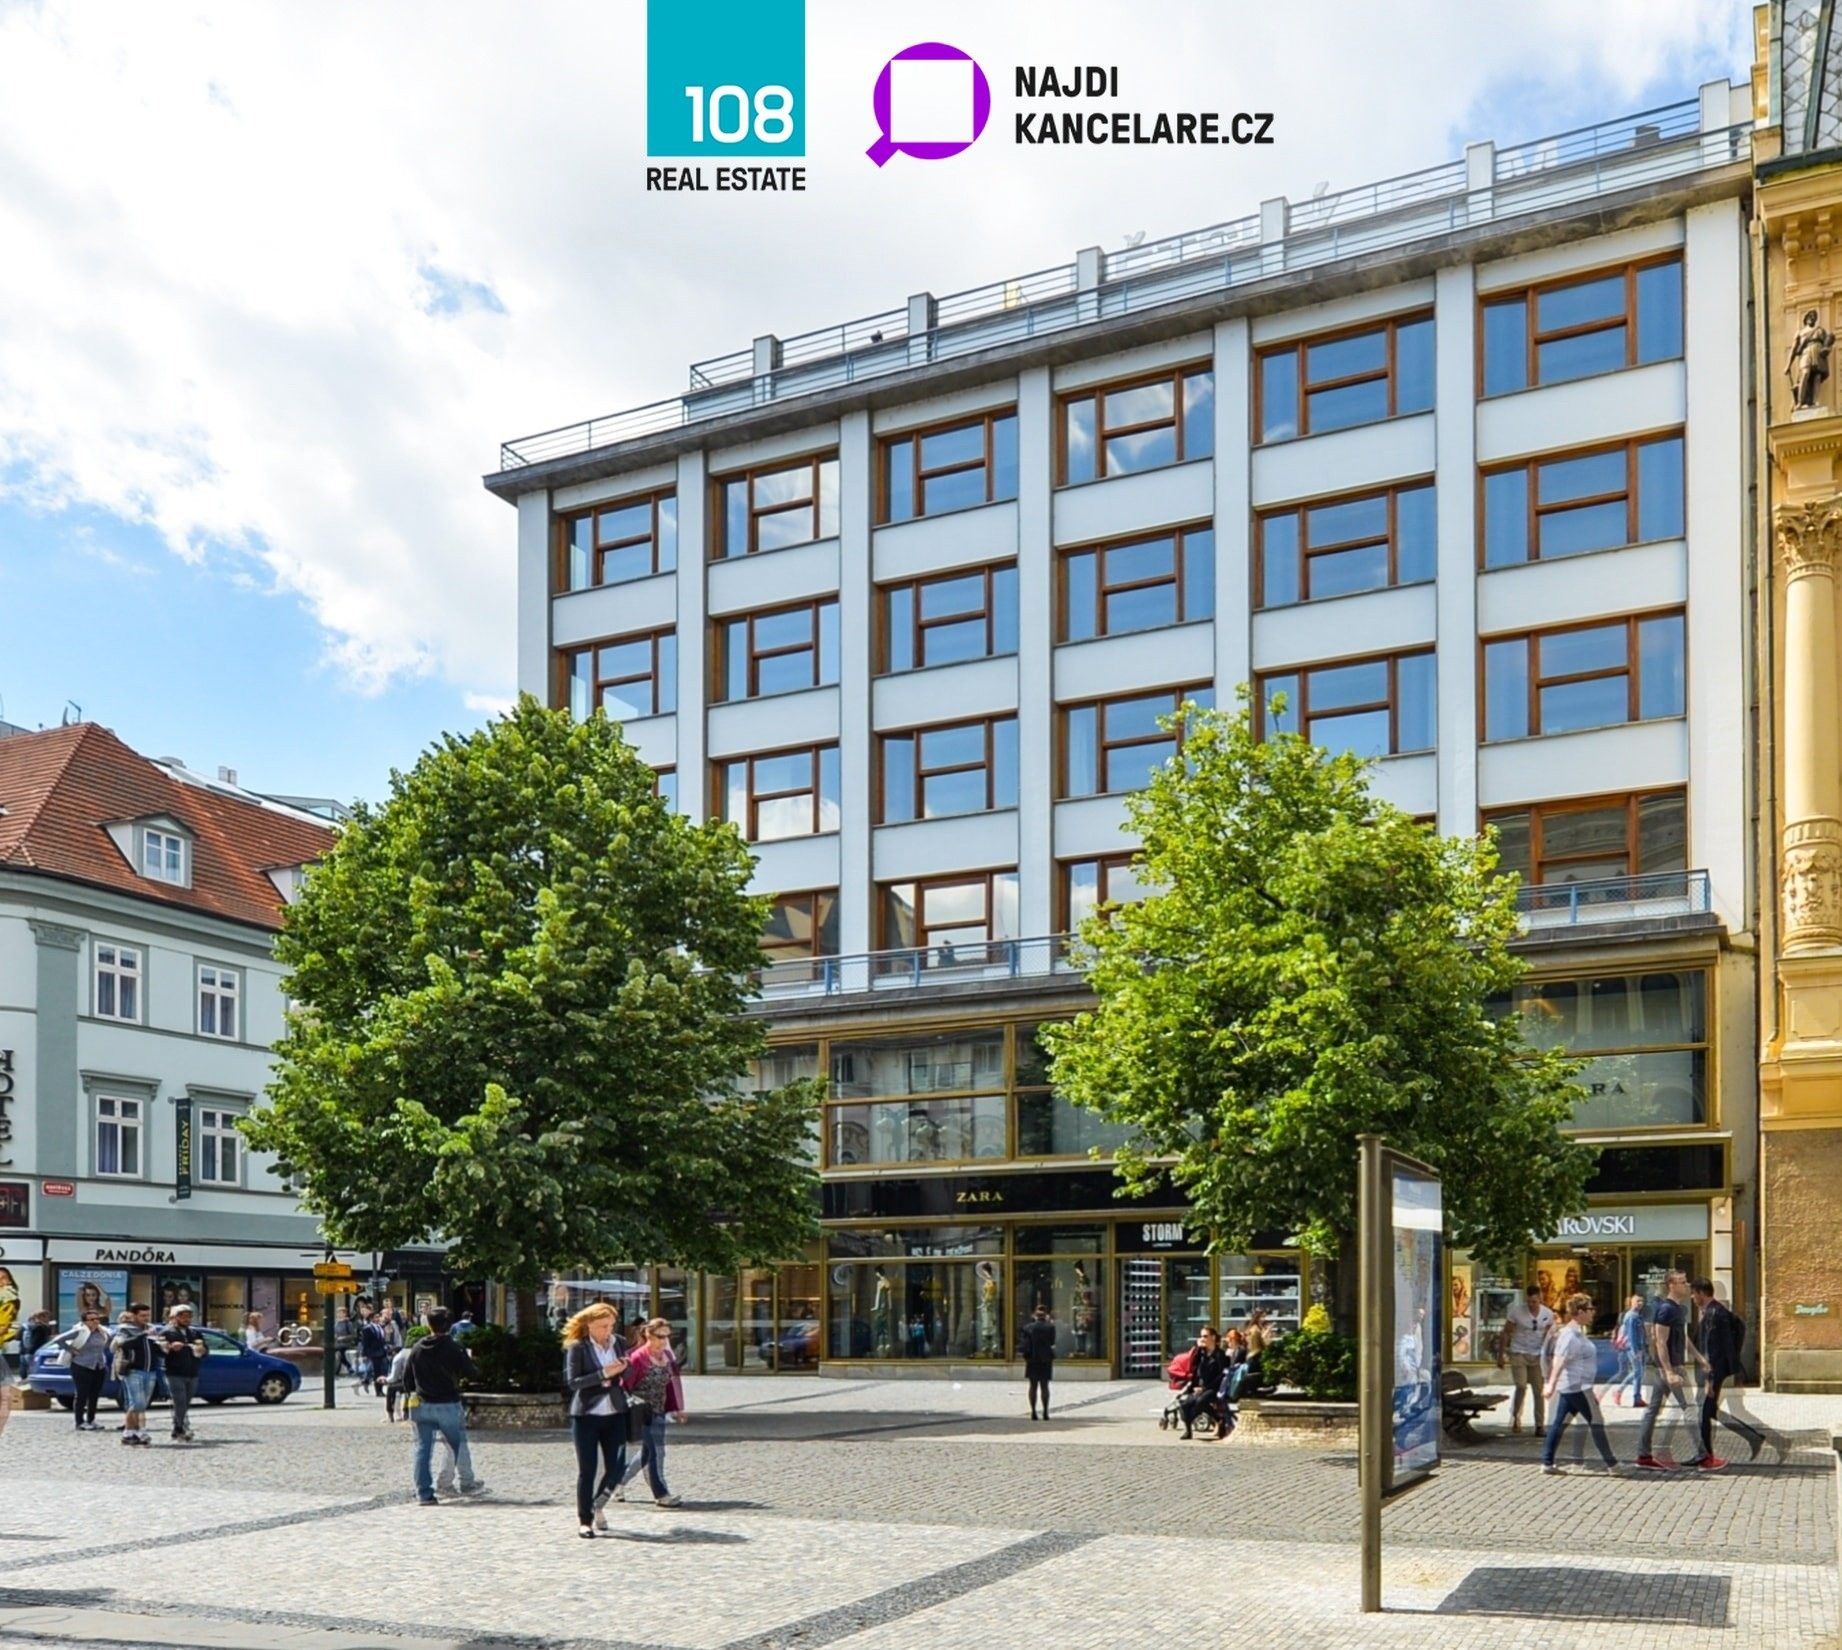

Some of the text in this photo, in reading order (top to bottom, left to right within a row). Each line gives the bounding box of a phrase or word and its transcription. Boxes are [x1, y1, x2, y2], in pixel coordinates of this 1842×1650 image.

[181, 1120, 190, 1175] FRIDAY
[956, 1191, 1004, 1202] ZARA
[1142, 1223, 1183, 1242] STORM
[1556, 1215, 1635, 1235] ROVSKI
